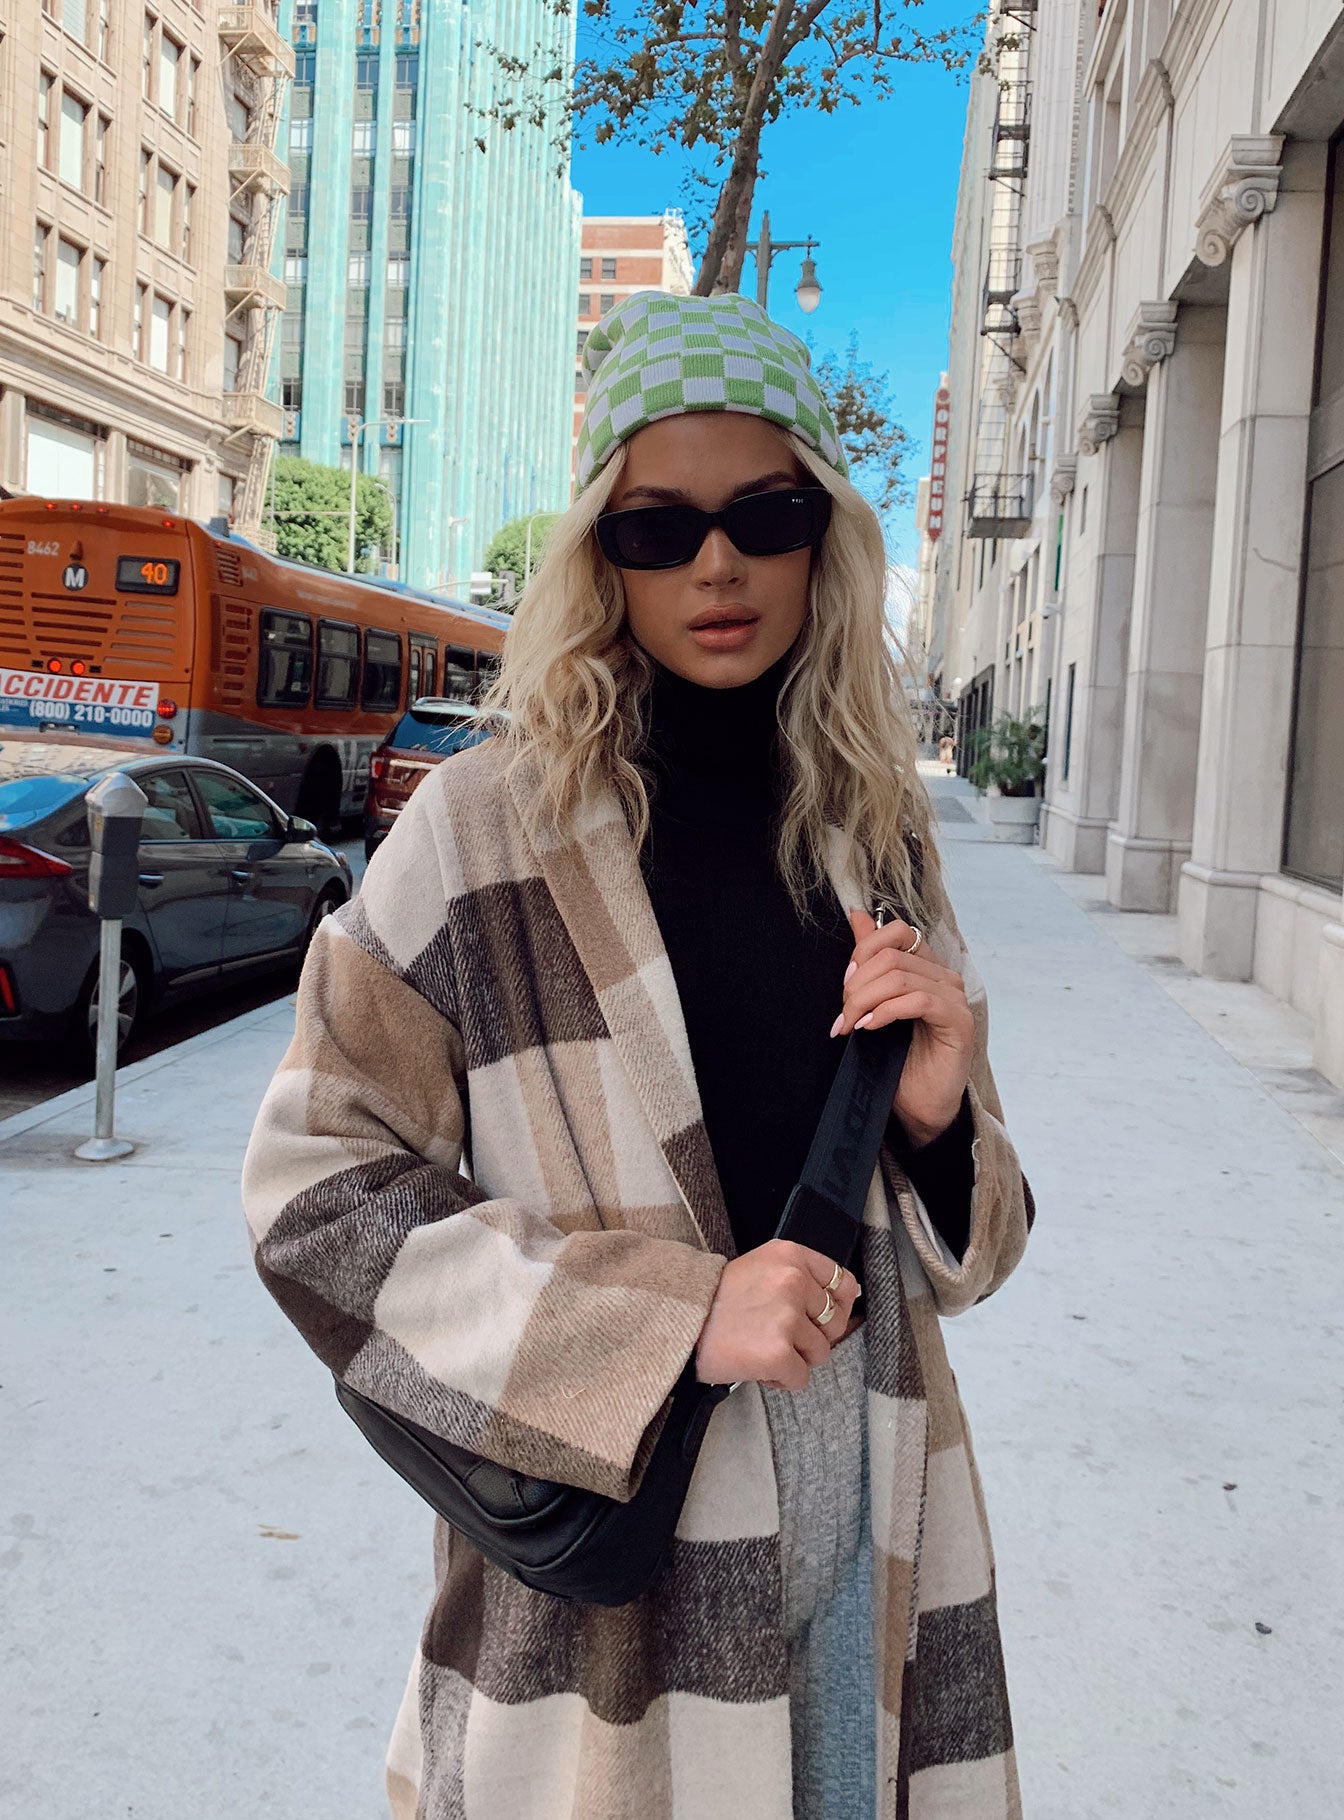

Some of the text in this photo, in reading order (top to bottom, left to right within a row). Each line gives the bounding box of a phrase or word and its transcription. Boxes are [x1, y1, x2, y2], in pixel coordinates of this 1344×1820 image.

[929, 409, 949, 530] ORPHEUM
[27, 541, 60, 557] 8462
[65, 567, 86, 587] M
[141, 562, 168, 586] 40
[0, 673, 154, 707] CCIDENTE
[29, 700, 70, 721] (800)
[74, 705, 153, 728] 210-0000
